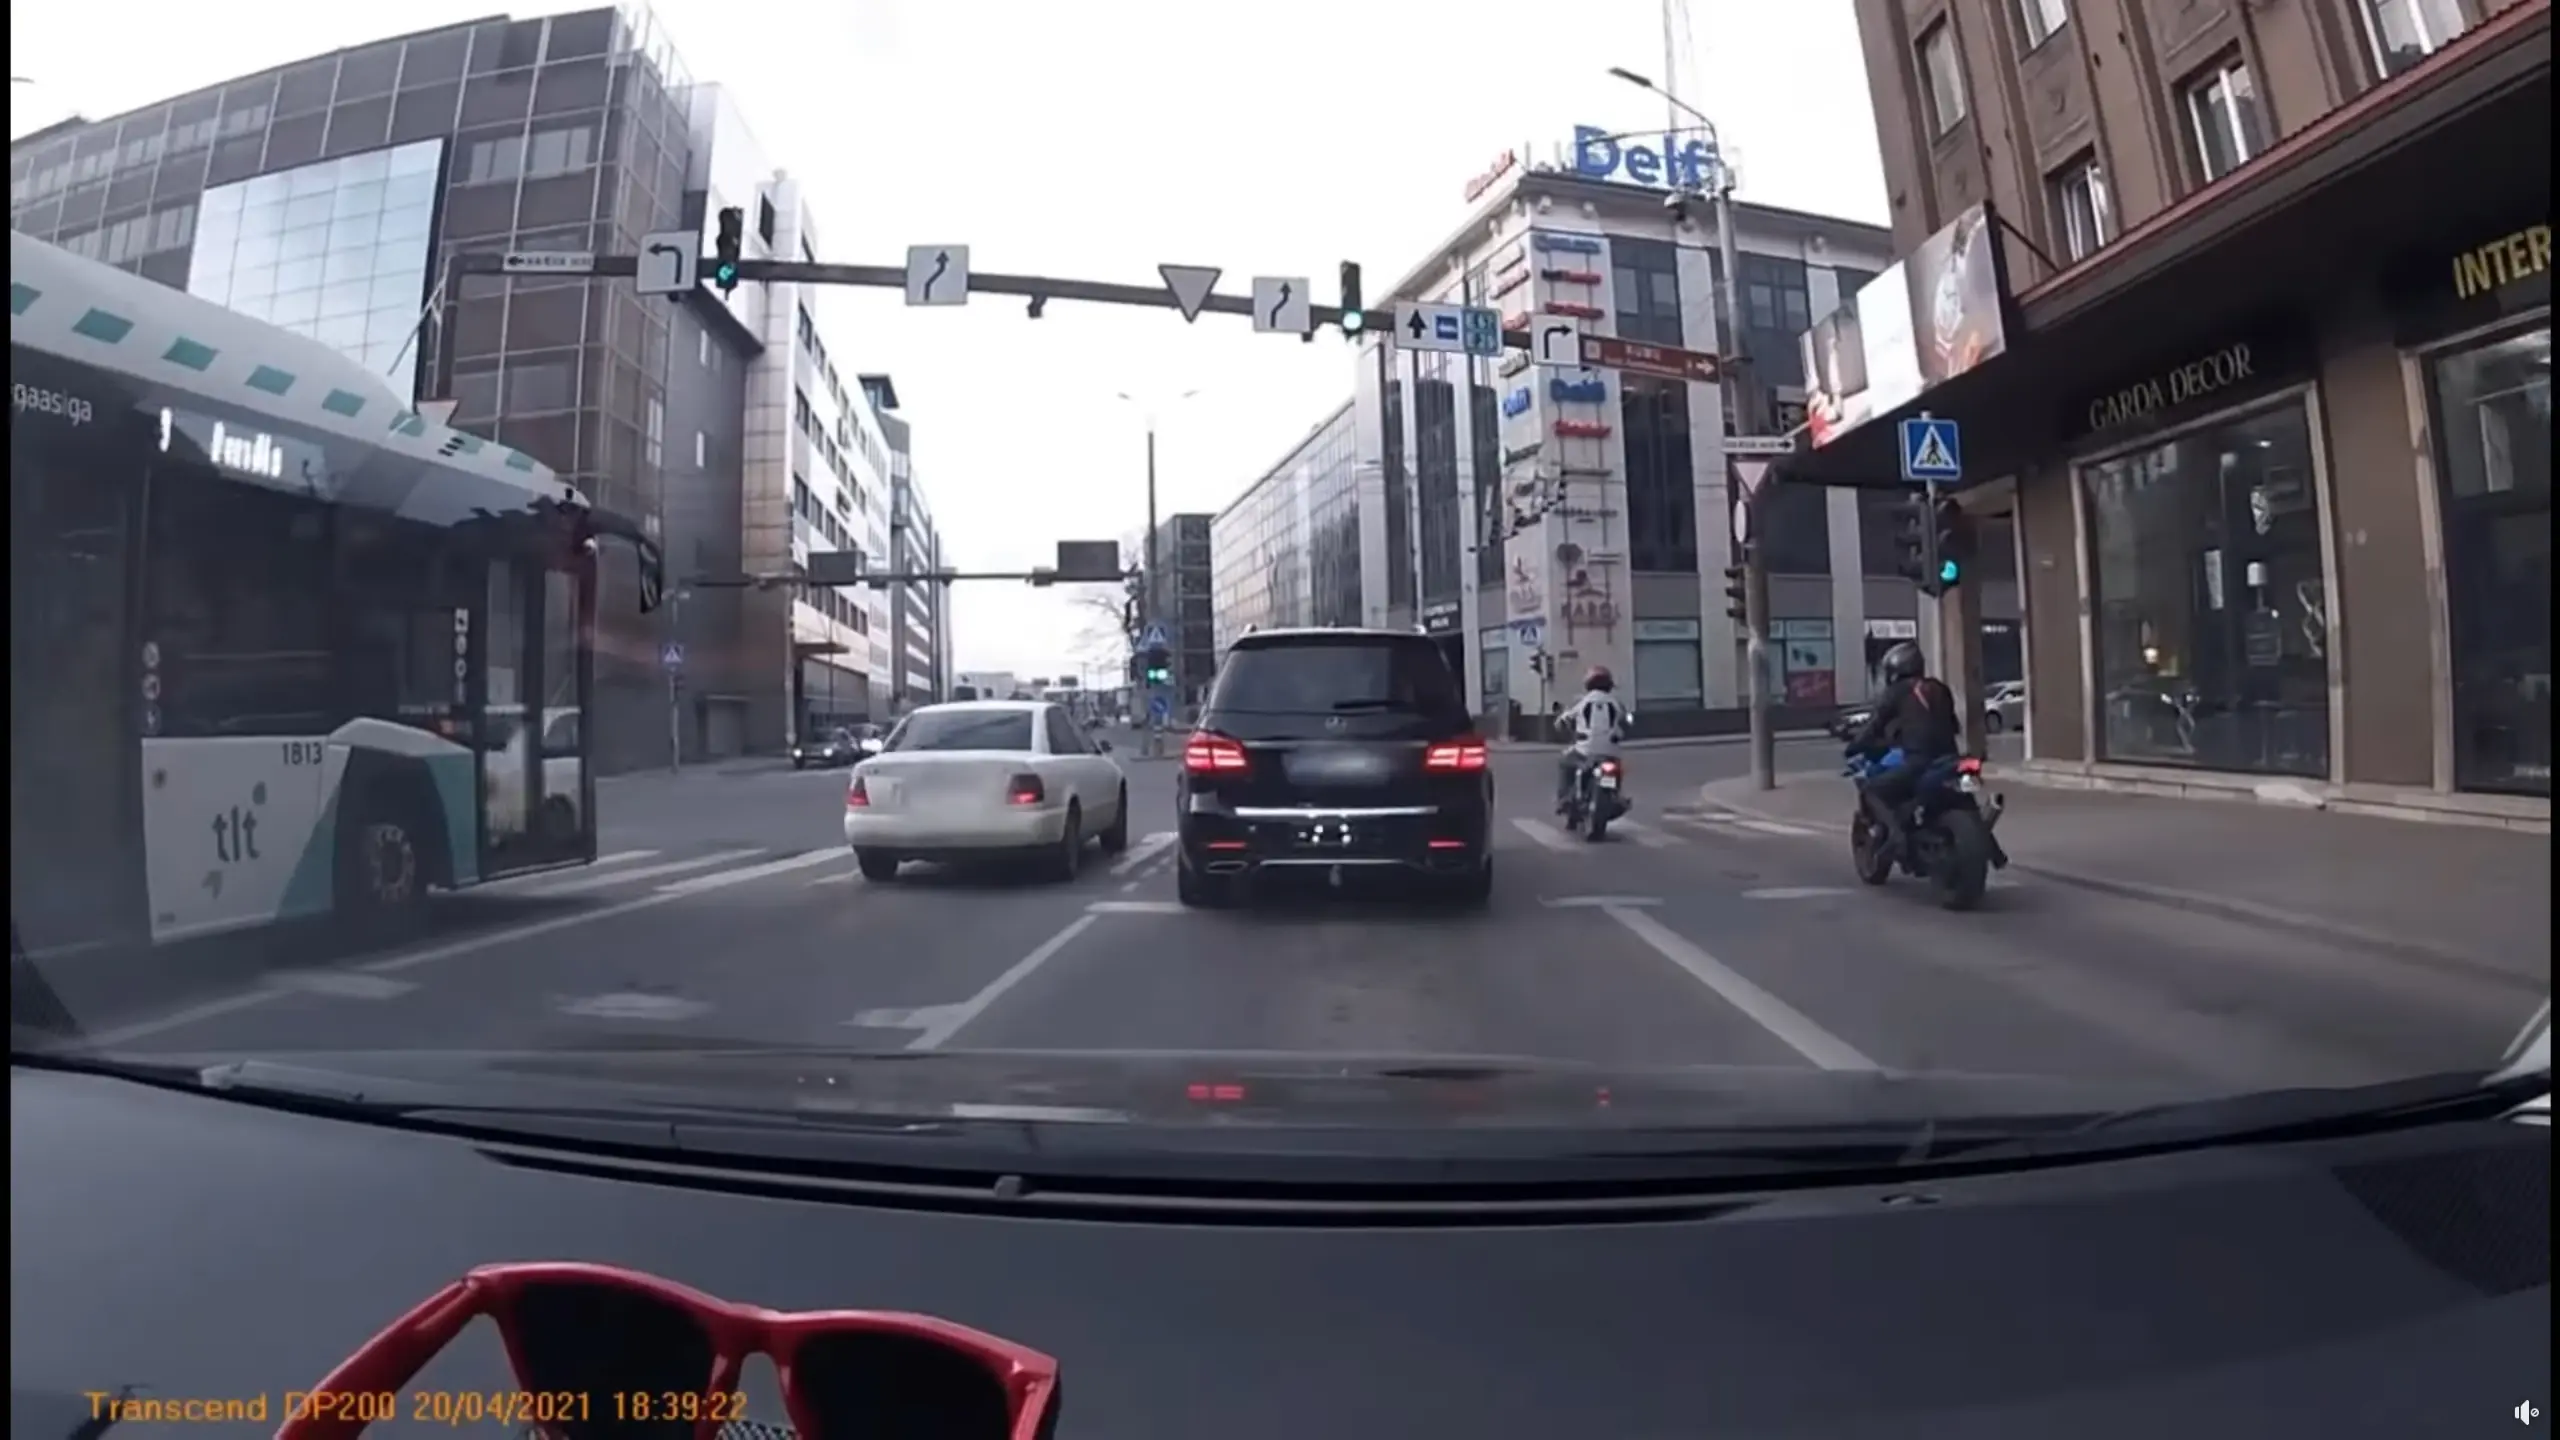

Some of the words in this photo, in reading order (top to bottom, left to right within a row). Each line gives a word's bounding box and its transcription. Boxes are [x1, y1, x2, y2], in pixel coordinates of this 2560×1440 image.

[1574, 124, 1718, 189] Delf
[2453, 225, 2551, 299] INTER
[2089, 378, 2165, 430] GARDA
[2169, 342, 2255, 404] DECOR
[282, 742, 322, 765] 1813
[212, 805, 260, 863] tlt
